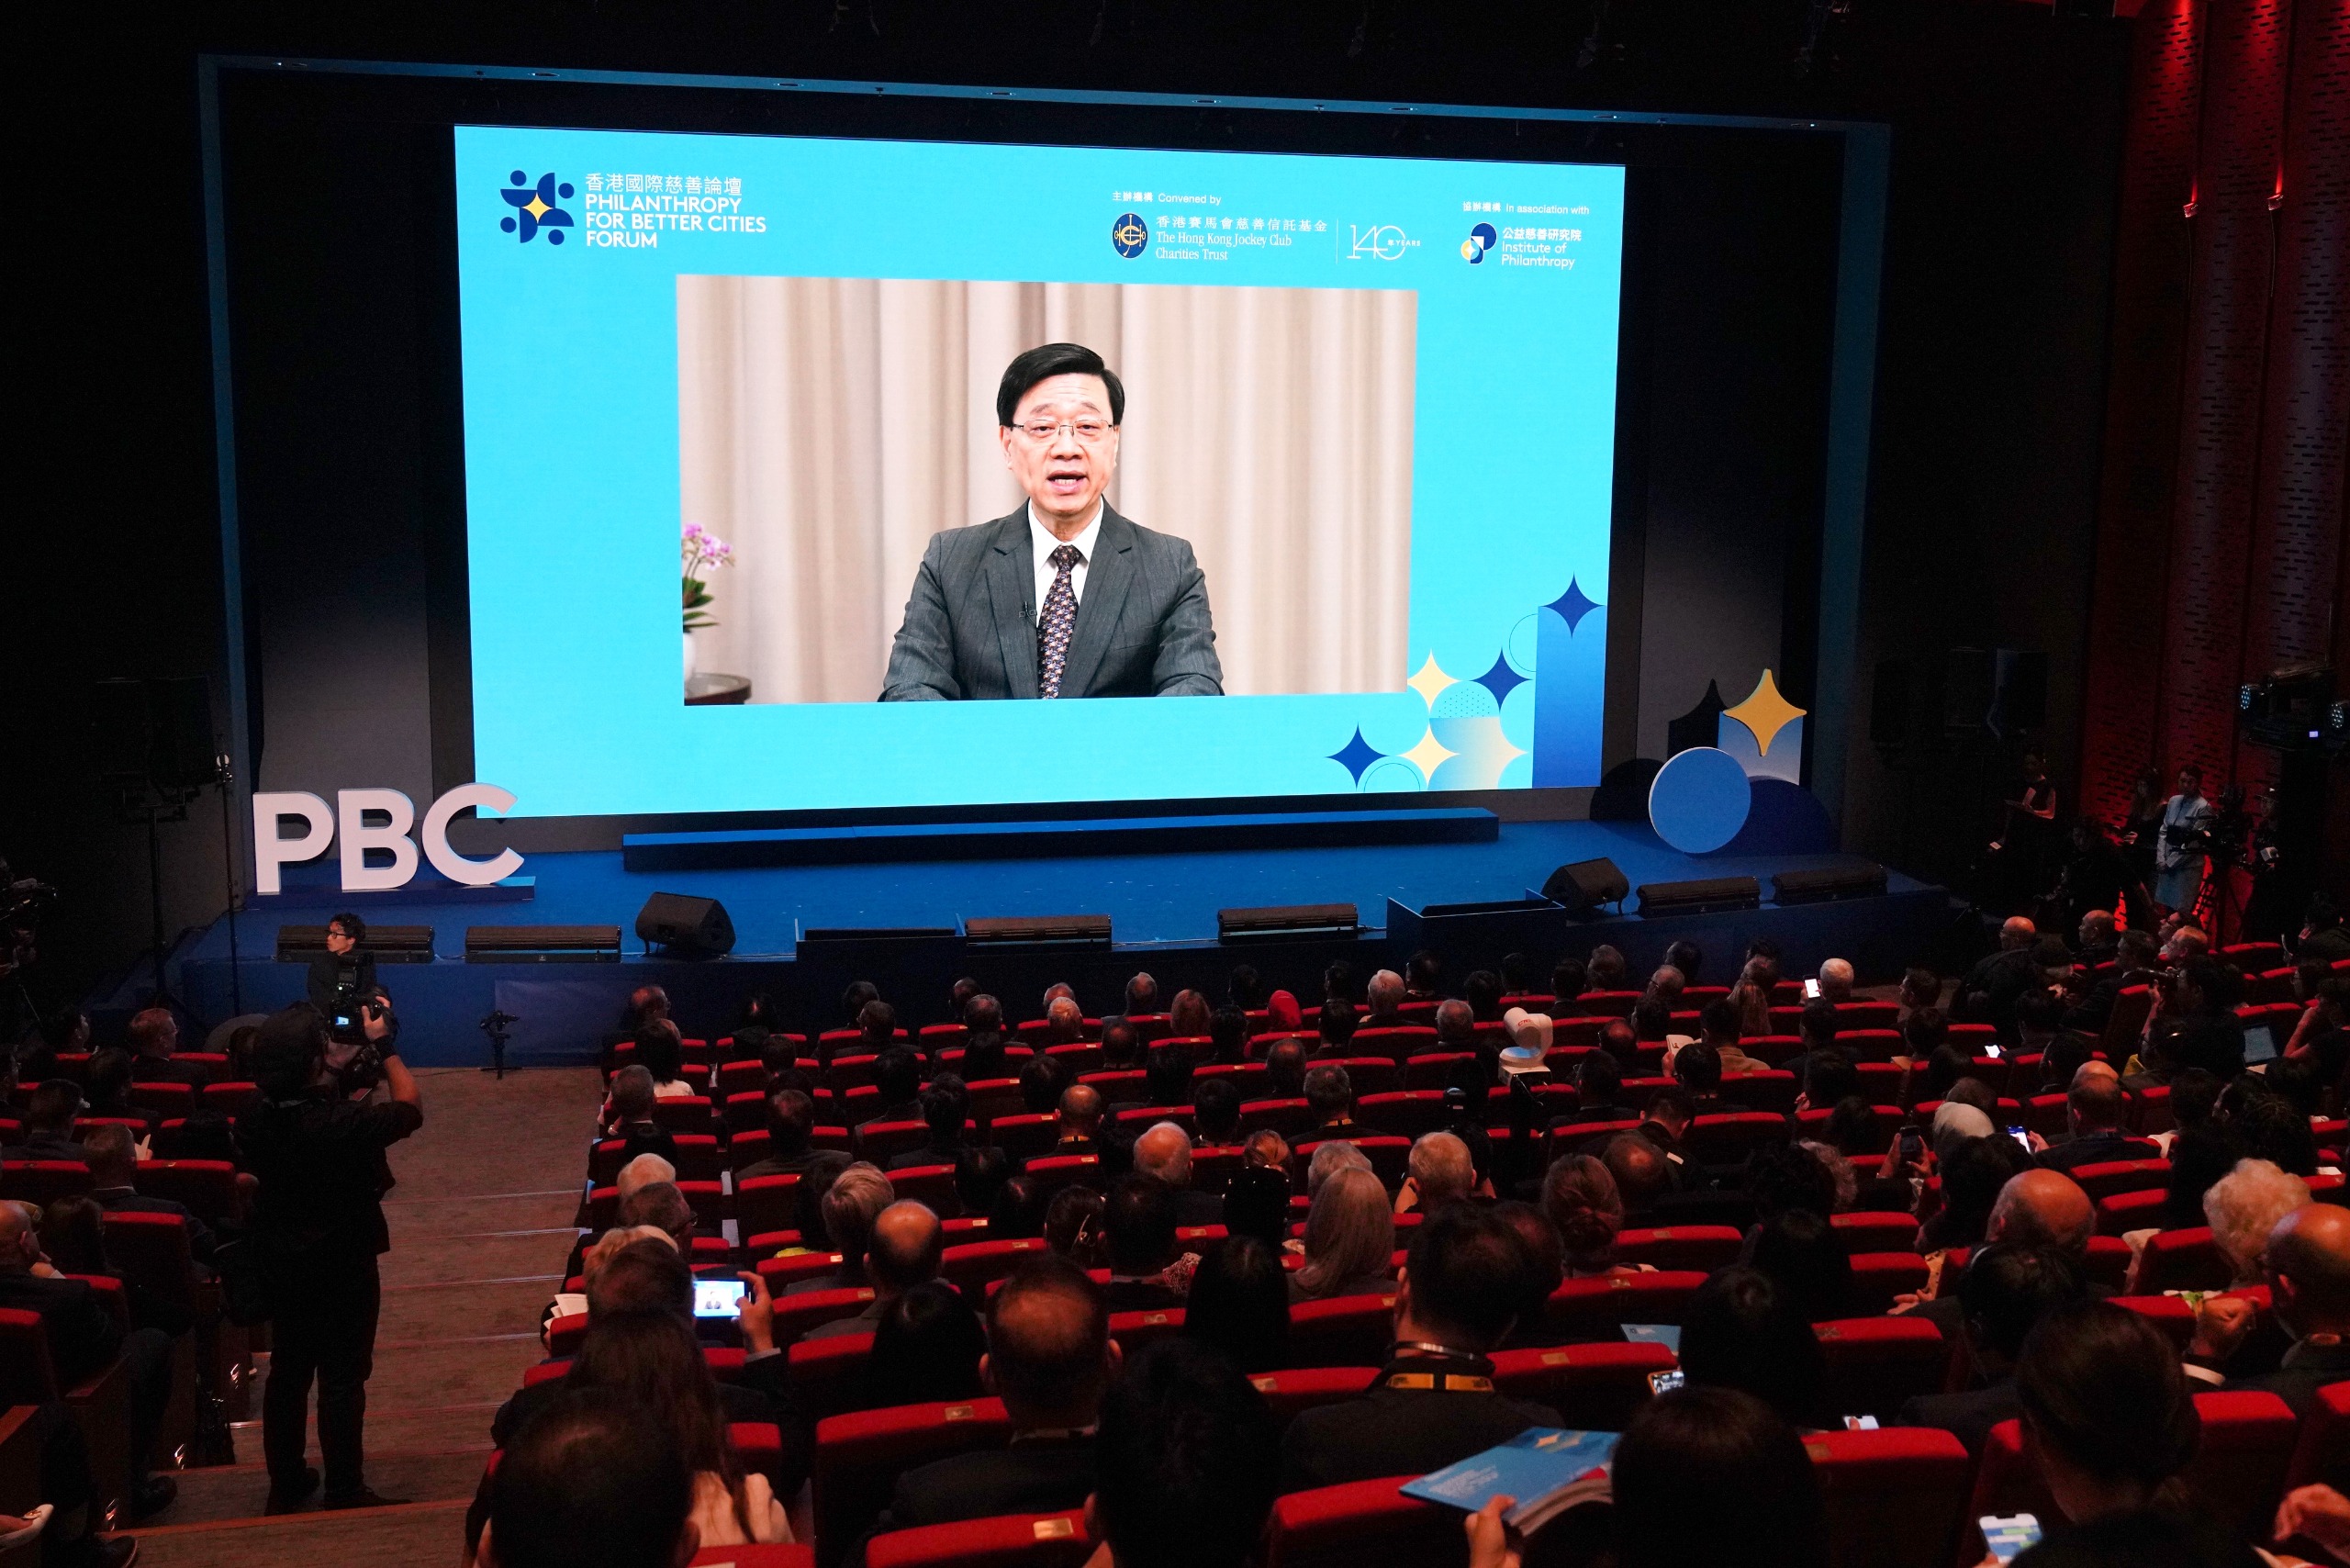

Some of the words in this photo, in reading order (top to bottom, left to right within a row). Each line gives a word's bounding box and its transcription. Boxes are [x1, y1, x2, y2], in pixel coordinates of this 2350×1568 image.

[585, 173, 743, 196] 香港國際慈善論壇
[585, 194, 743, 214] PHILANTHROPY
[1112, 191, 1154, 203] 主辦機構
[1158, 193, 1207, 204] Convened
[1209, 195, 1222, 207] by
[1505, 204, 1515, 213] In
[1516, 204, 1569, 215] association
[1570, 205, 1590, 216] with
[586, 211, 626, 230] FOR
[632, 213, 704, 231] BETTER
[707, 215, 767, 233] CITIES
[1156, 215, 1327, 232] 香港賽馬會慈善信託基金
[586, 230, 658, 249] FORUM
[1156, 230, 1176, 243] The
[1178, 231, 1205, 247] Hong
[1207, 232, 1233, 248] Kong
[1233, 233, 1268, 249] Jockey
[1269, 233, 1292, 247] Club
[1346, 224, 1406, 261] 140
[1395, 239, 1421, 247] YEARS
[1502, 227, 1583, 242] 公益慈善研究院
[1155, 247, 1200, 260] Charities
[1202, 248, 1232, 261] Trust
[1502, 241, 1551, 253] Institute
[1554, 243, 1568, 254] of
[1501, 253, 1576, 271] Philanthropy
[252, 782, 525, 894] PBC
